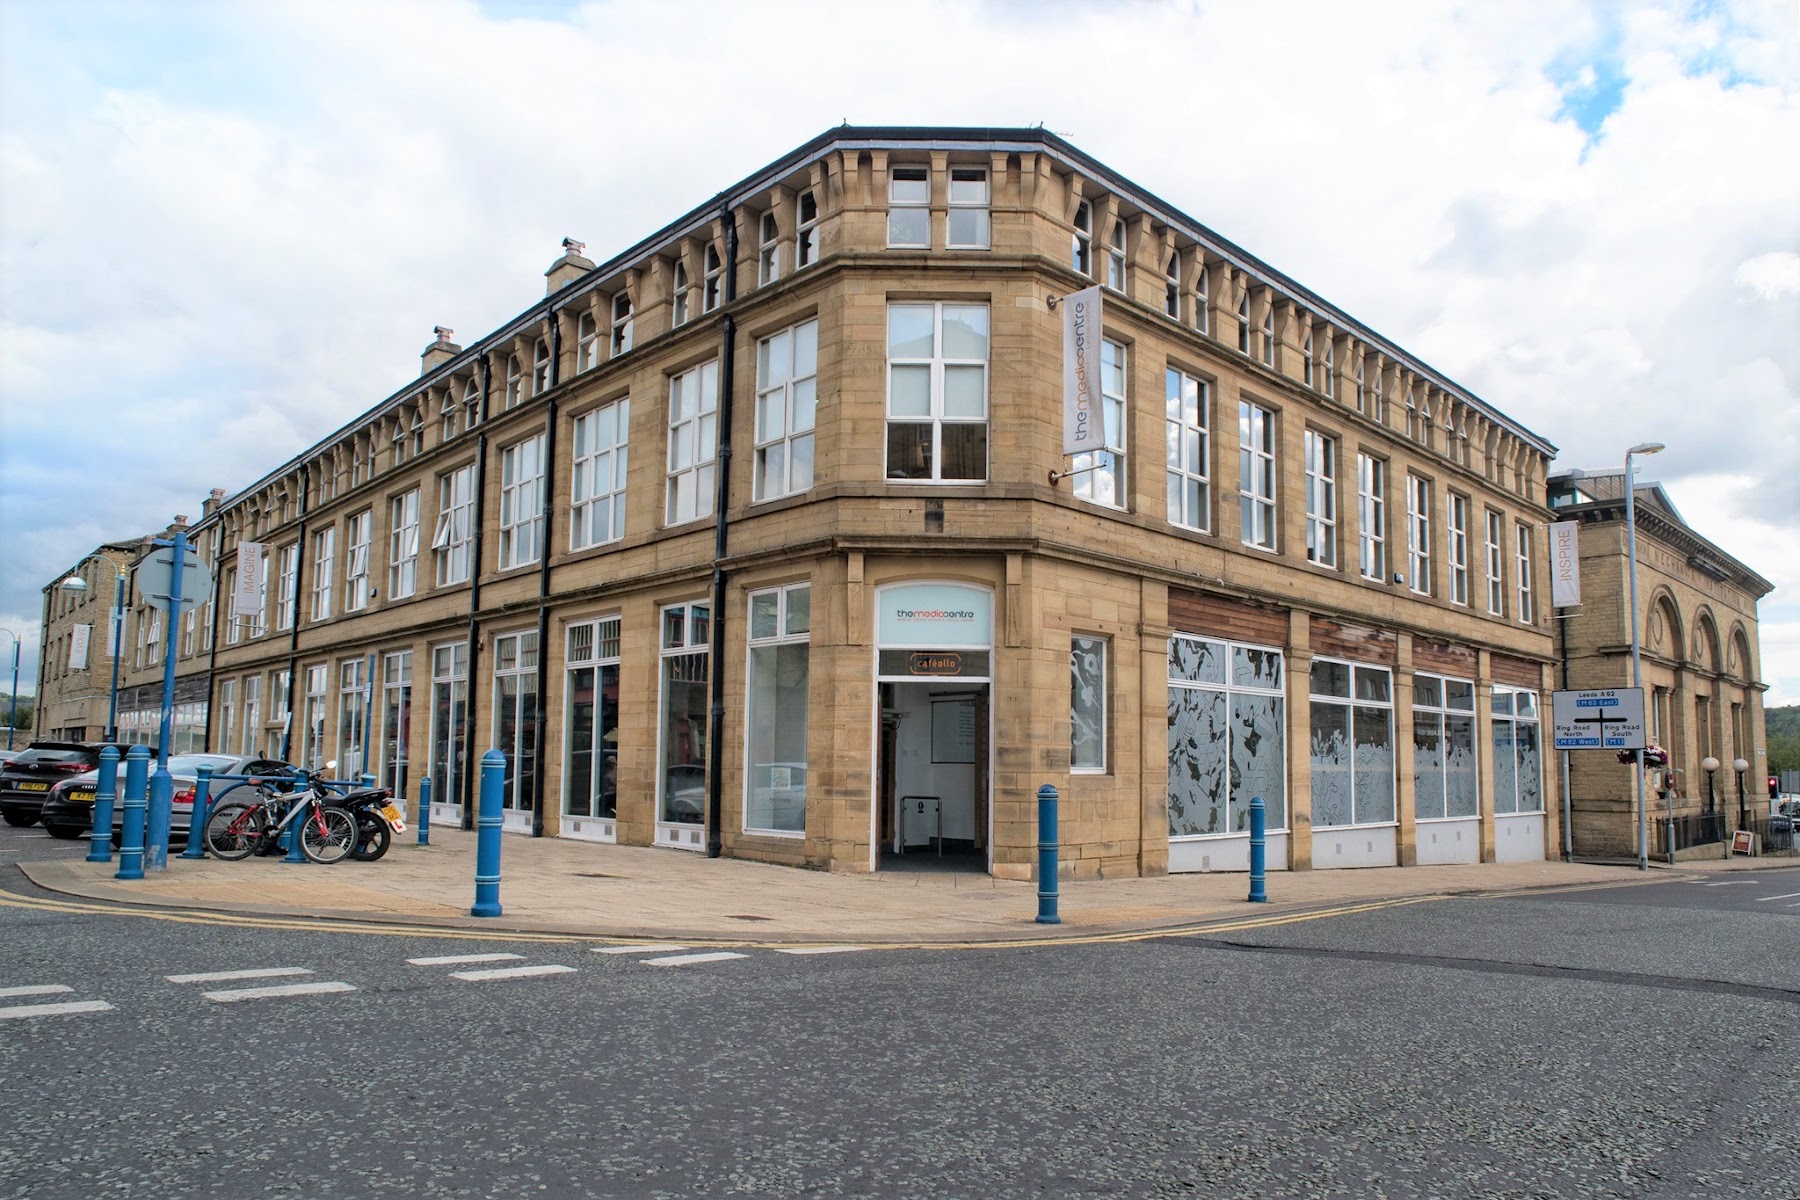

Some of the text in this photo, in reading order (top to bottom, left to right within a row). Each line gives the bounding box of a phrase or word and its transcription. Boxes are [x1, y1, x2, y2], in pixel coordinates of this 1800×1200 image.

[243, 546, 255, 593] IMAGINE
[1558, 529, 1572, 582] INSPIRE
[76, 626, 86, 653] EVOLVE
[394, 821, 403, 829] L
